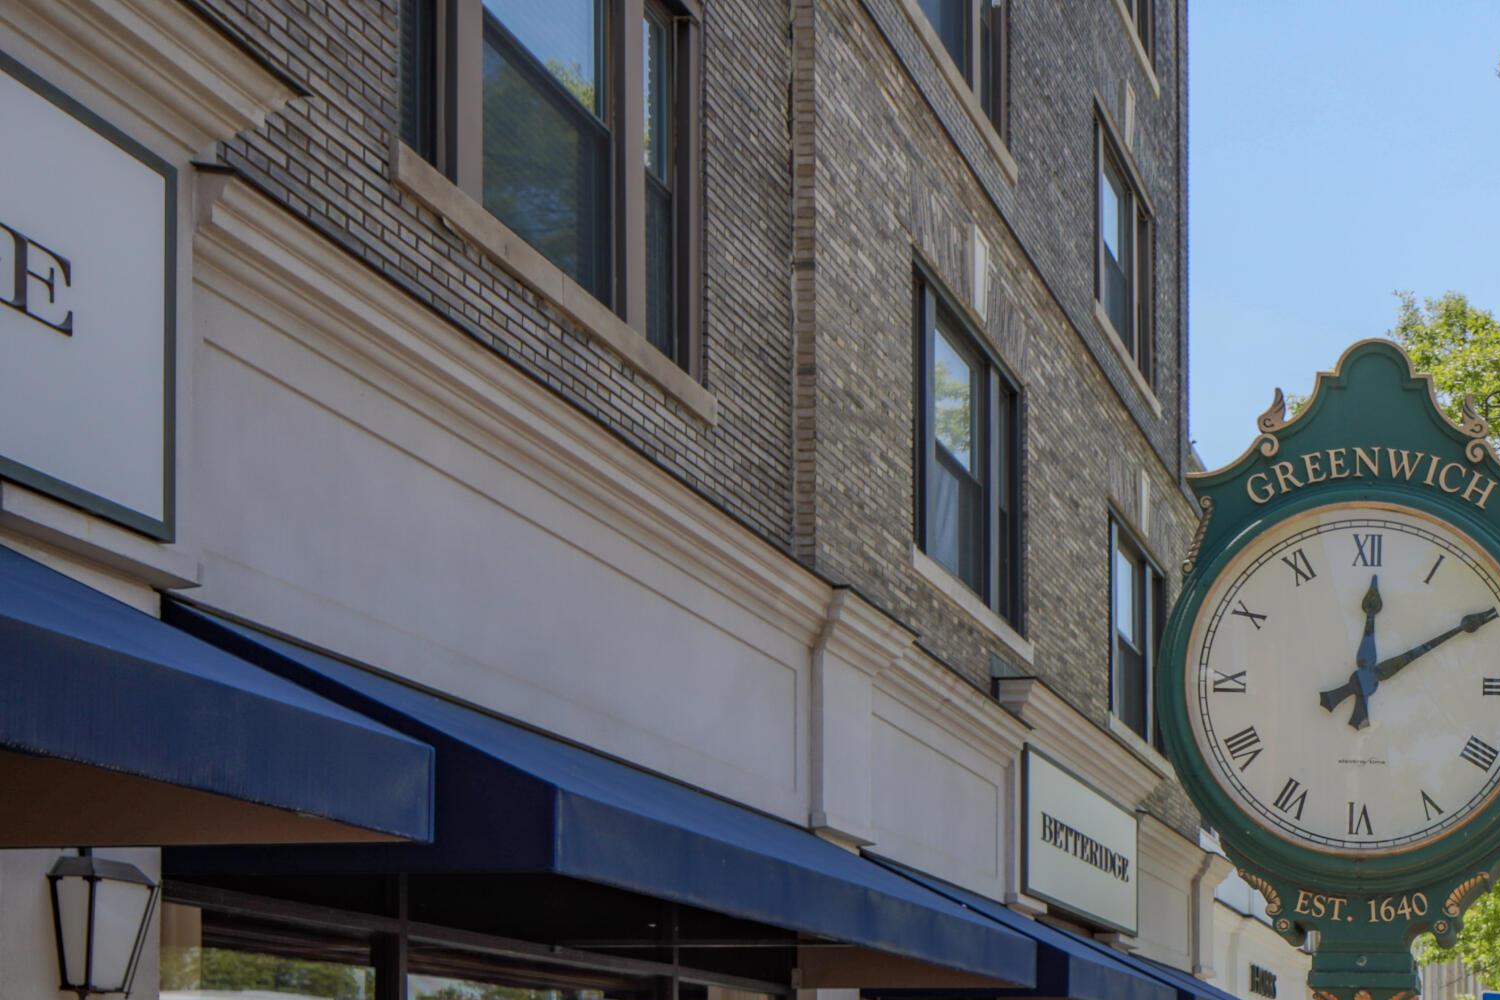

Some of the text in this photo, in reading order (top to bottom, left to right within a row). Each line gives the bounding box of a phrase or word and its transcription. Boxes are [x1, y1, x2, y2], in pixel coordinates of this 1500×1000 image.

[1246, 446, 1498, 509] GREENWICH
[1352, 533, 1383, 567] XII
[1281, 548, 1317, 587] XI
[1423, 554, 1445, 584] I
[1231, 600, 1267, 630] X
[1213, 670, 1247, 693] IX
[1224, 725, 1263, 772] VIII
[1460, 735, 1500, 772] IIII
[1273, 777, 1308, 821] VII
[1421, 789, 1444, 821] V
[1348, 801, 1374, 835] VI
[1041, 811, 1129, 883] BETTERIDGE
[1294, 889, 1429, 923] EST. 1640
